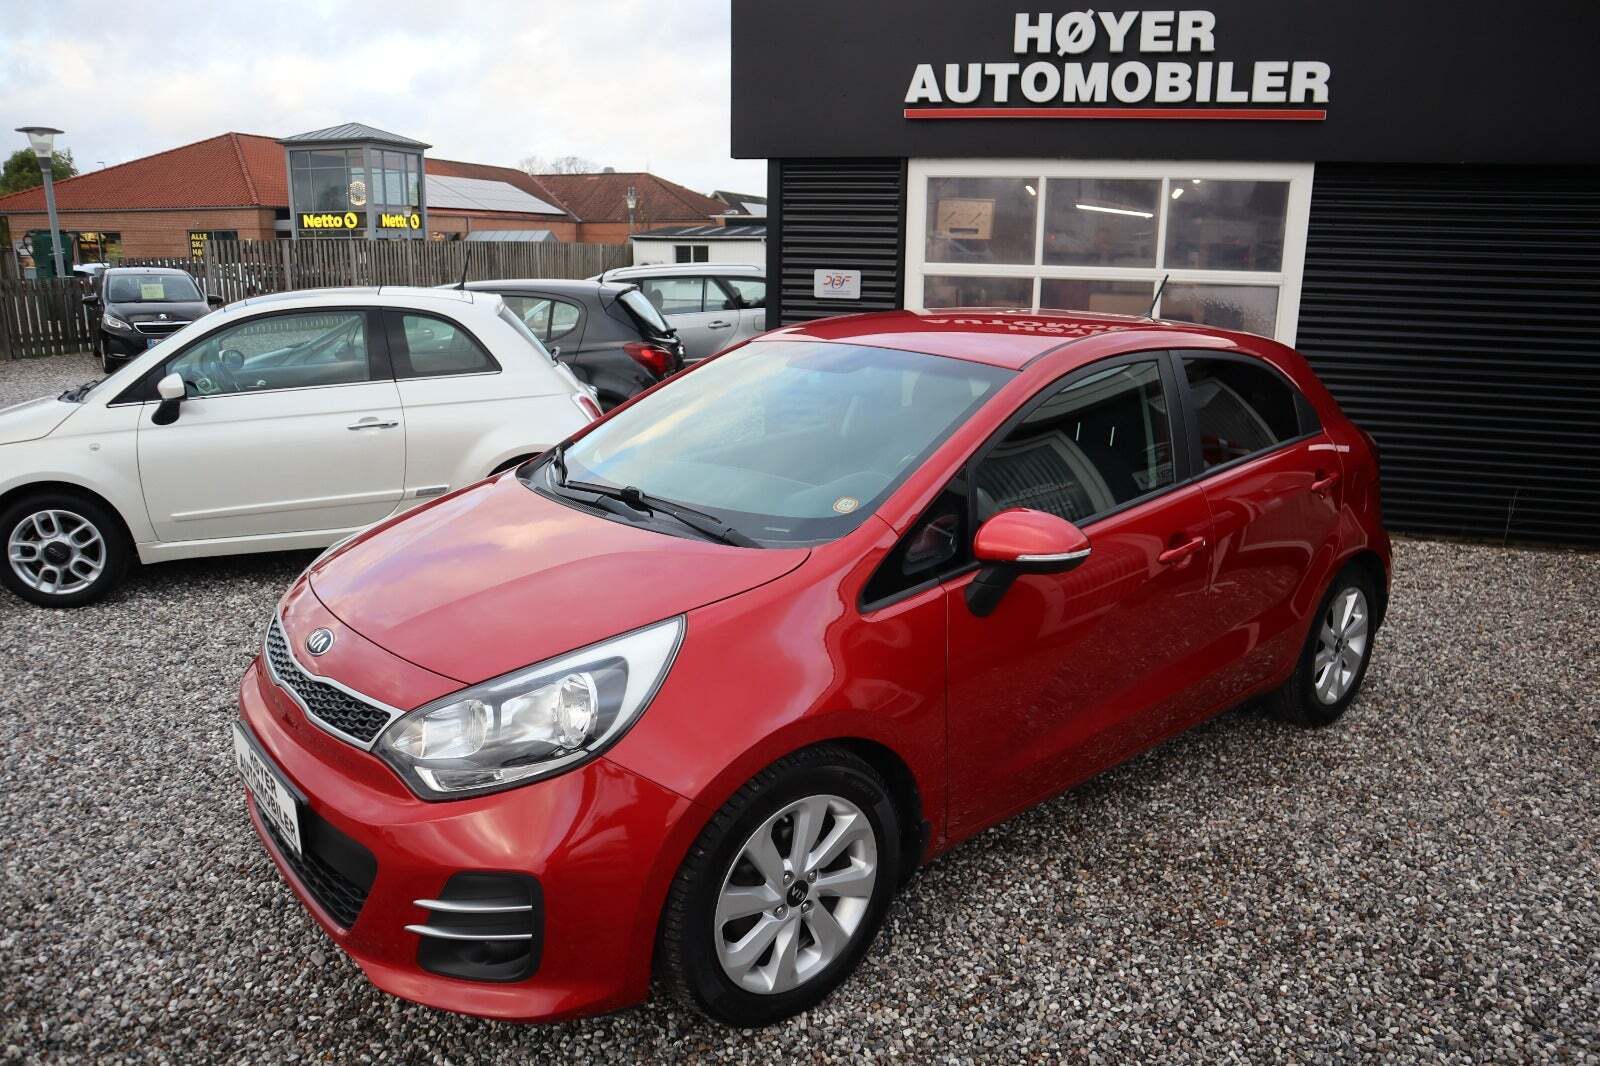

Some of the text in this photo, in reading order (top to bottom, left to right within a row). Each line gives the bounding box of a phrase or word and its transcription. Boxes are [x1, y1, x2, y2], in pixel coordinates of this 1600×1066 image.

[1013, 8, 1216, 57] HØYER
[904, 61, 1331, 103] AUTOMOBILER
[303, 214, 343, 229] Netto
[240, 753, 297, 841] AUTOMOBILER
[249, 749, 278, 798] HØYER
